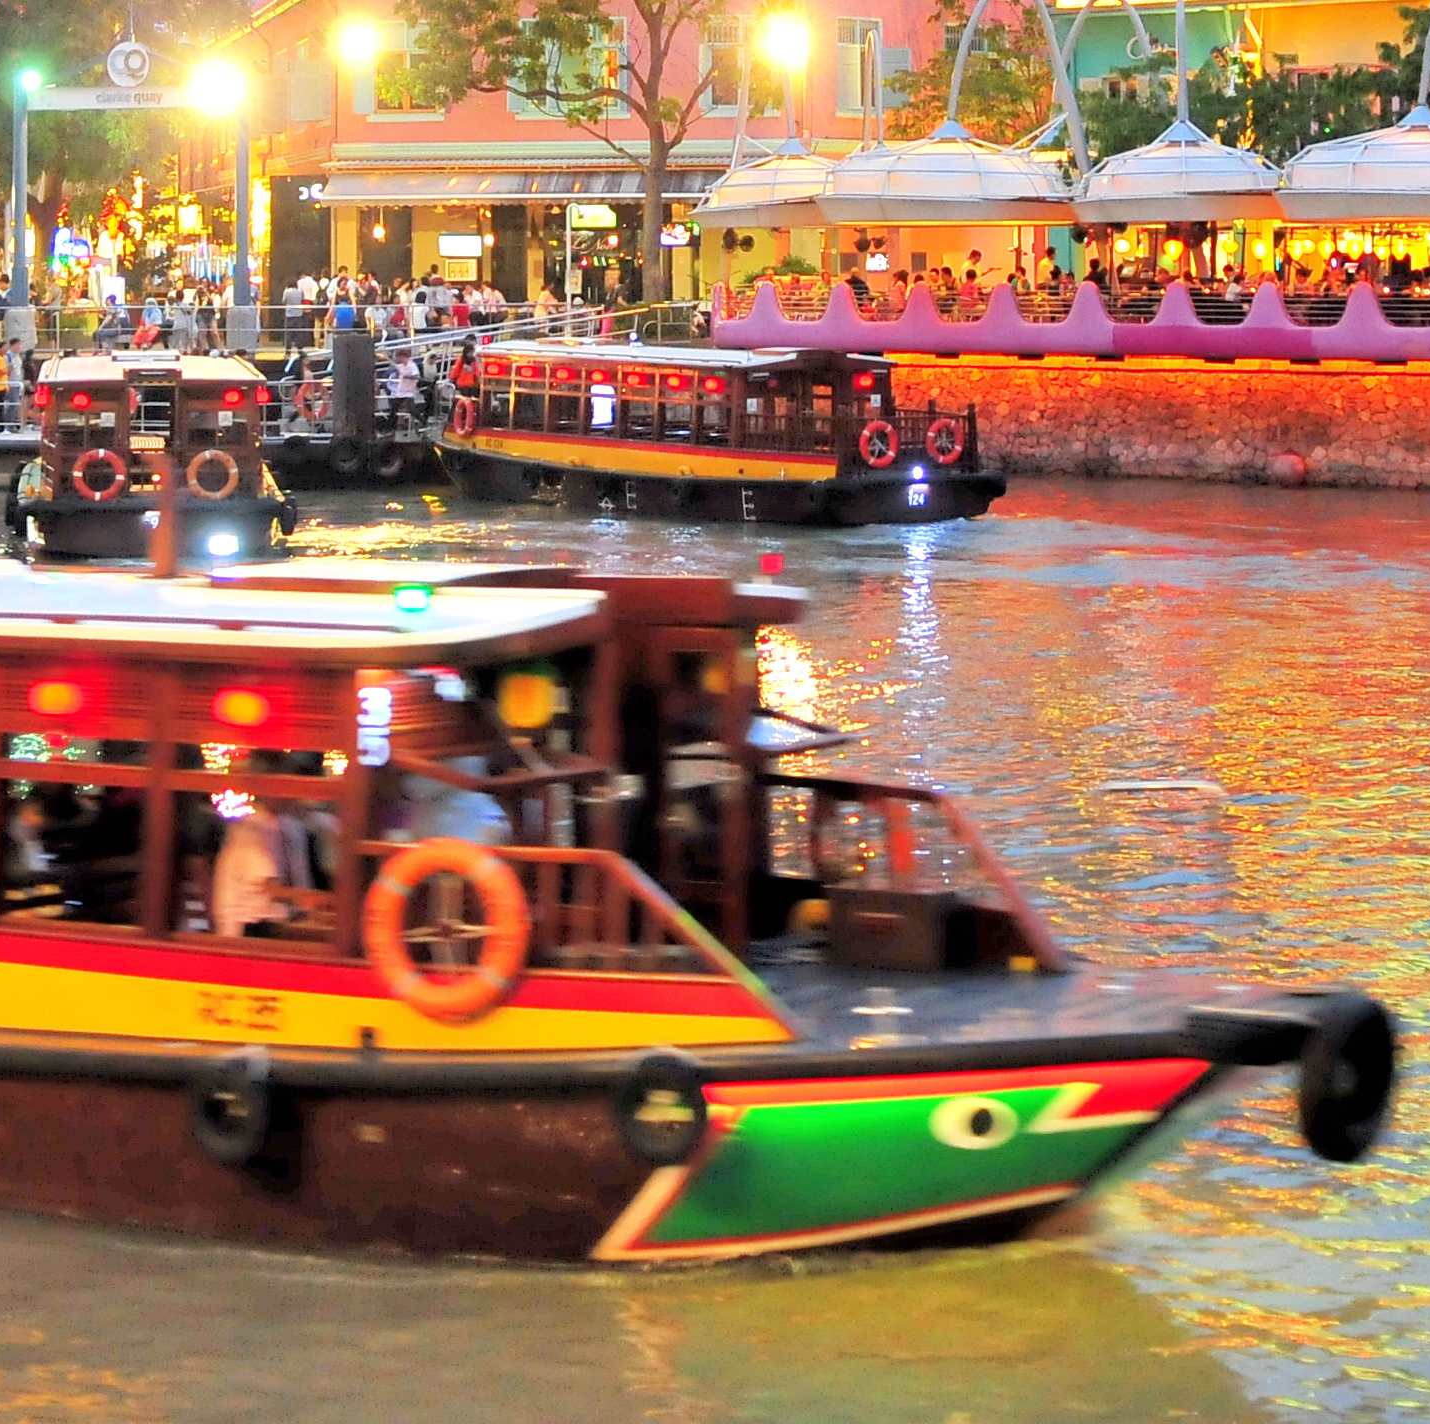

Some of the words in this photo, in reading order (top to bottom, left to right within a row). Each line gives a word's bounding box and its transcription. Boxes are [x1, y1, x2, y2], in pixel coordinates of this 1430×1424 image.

[96, 91, 132, 103] clarke
[134, 92, 163, 105] quay
[908, 492, 925, 507] 124
